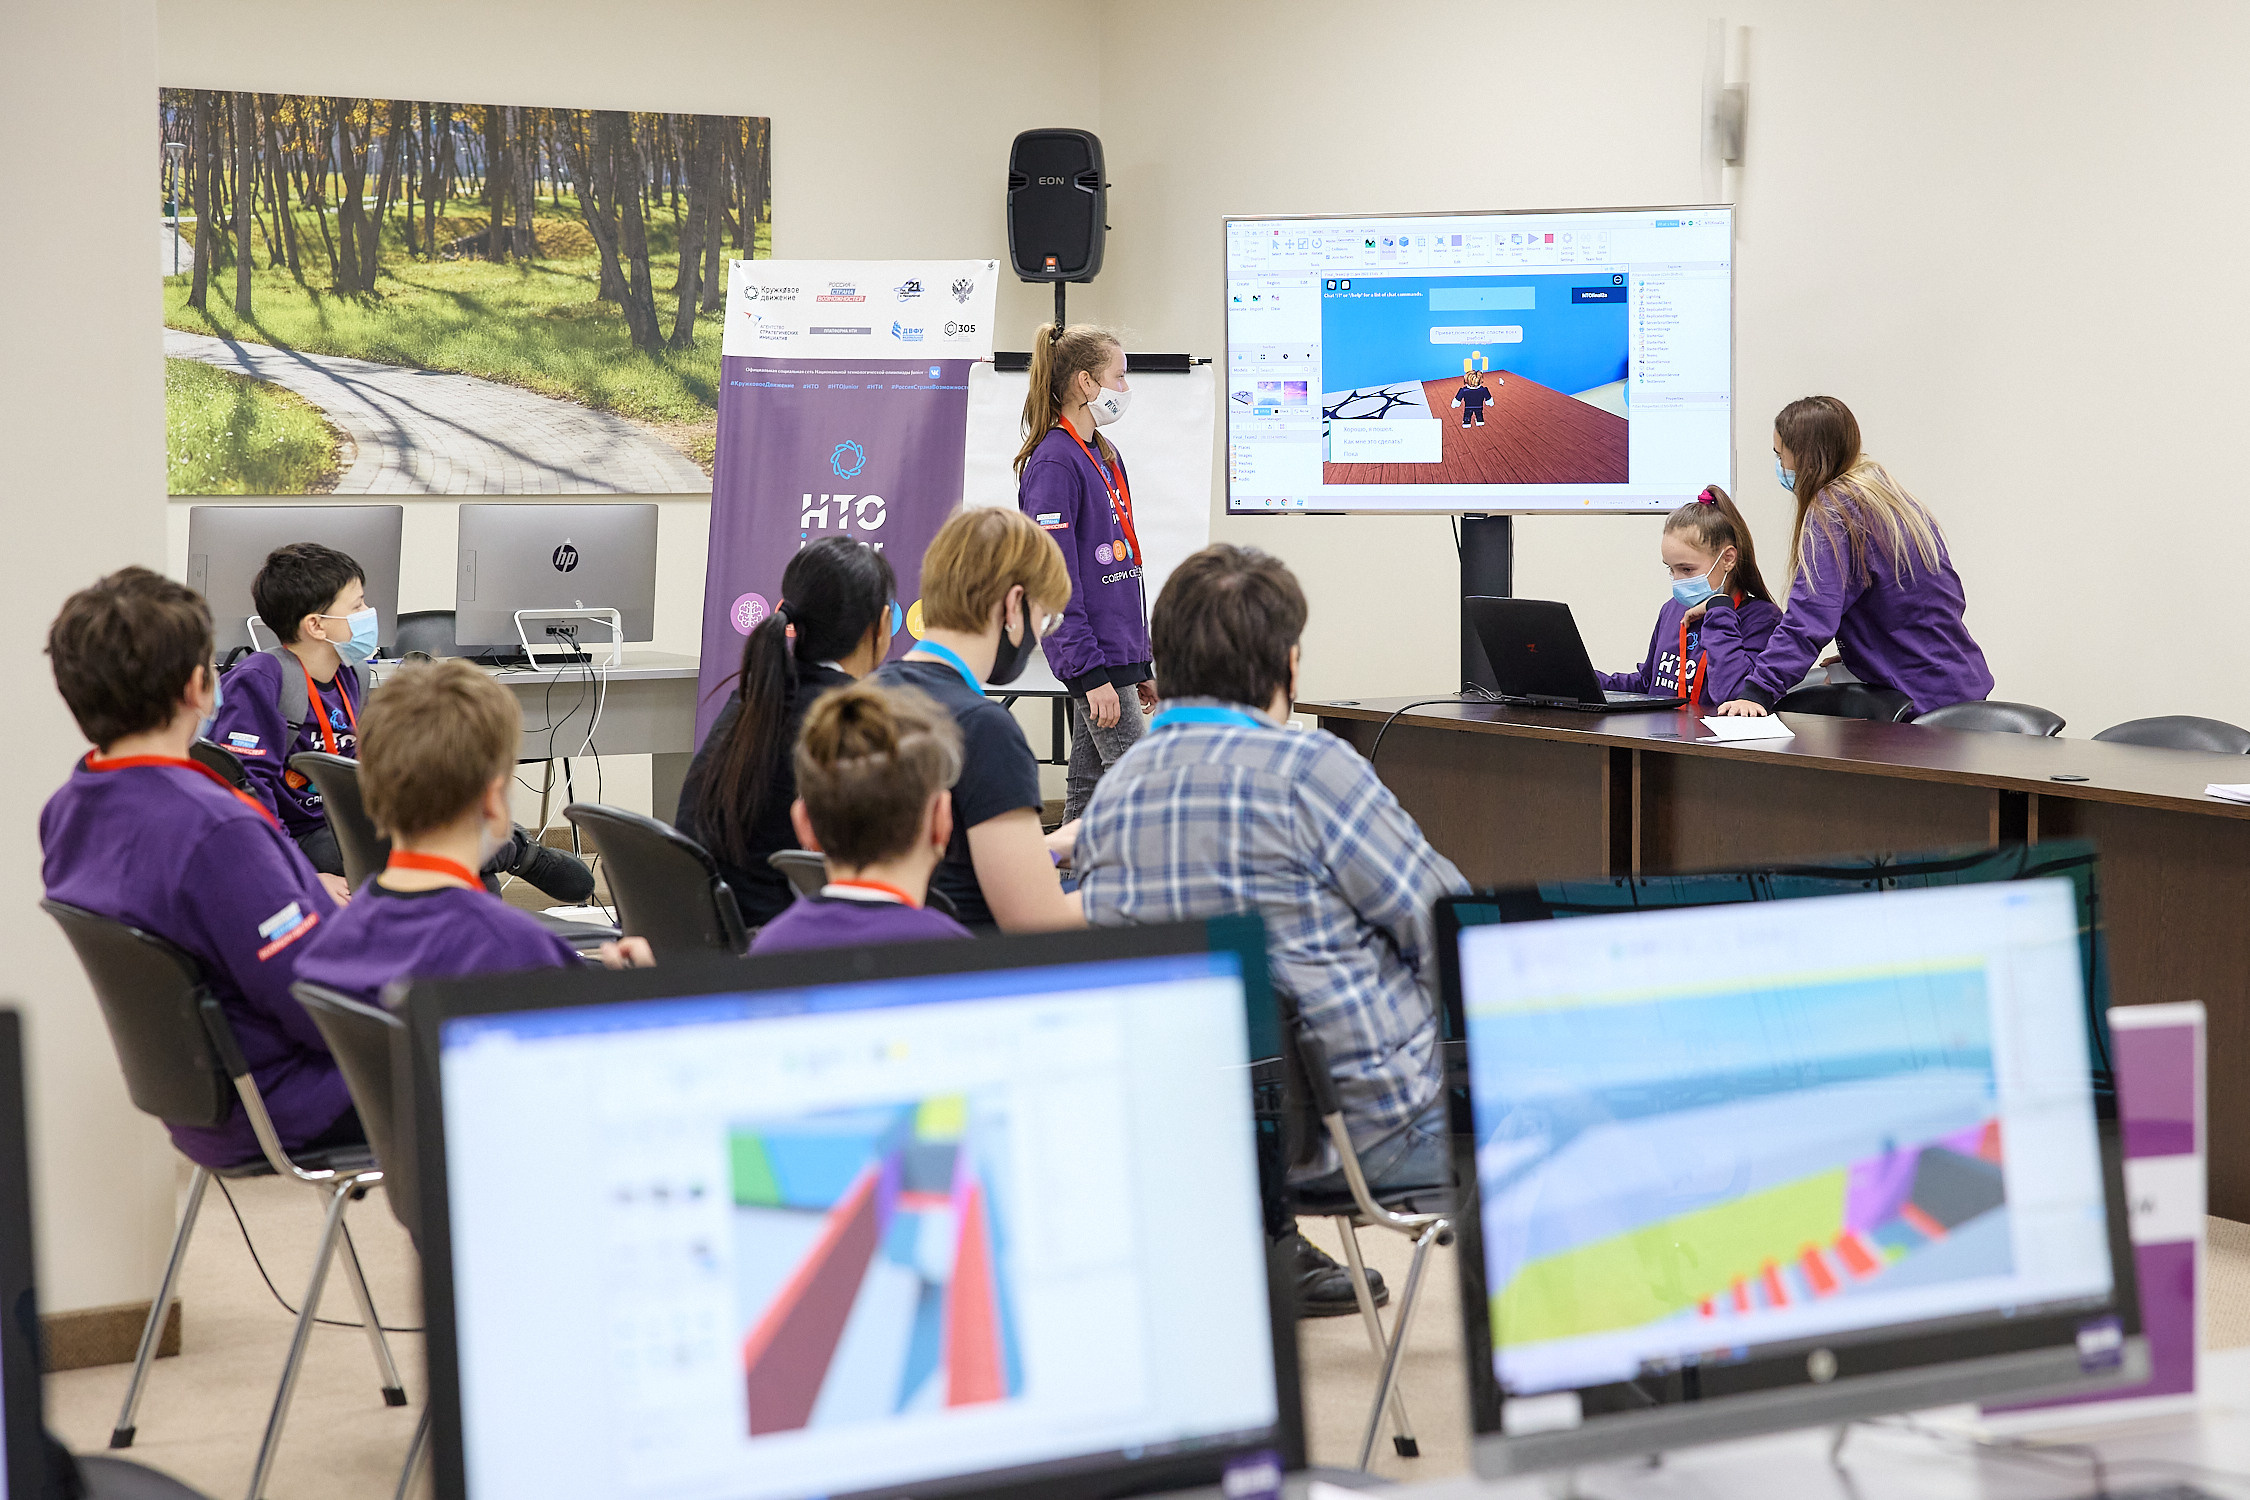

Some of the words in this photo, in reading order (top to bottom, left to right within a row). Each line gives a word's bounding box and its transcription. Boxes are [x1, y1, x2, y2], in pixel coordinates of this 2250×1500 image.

[1038, 176, 1065, 185] EON
[760, 286, 800, 294] Кружковое
[760, 294, 796, 302] движение
[958, 324, 976, 333] 305
[555, 545, 577, 573] hp
[1655, 672, 1694, 693] junir
